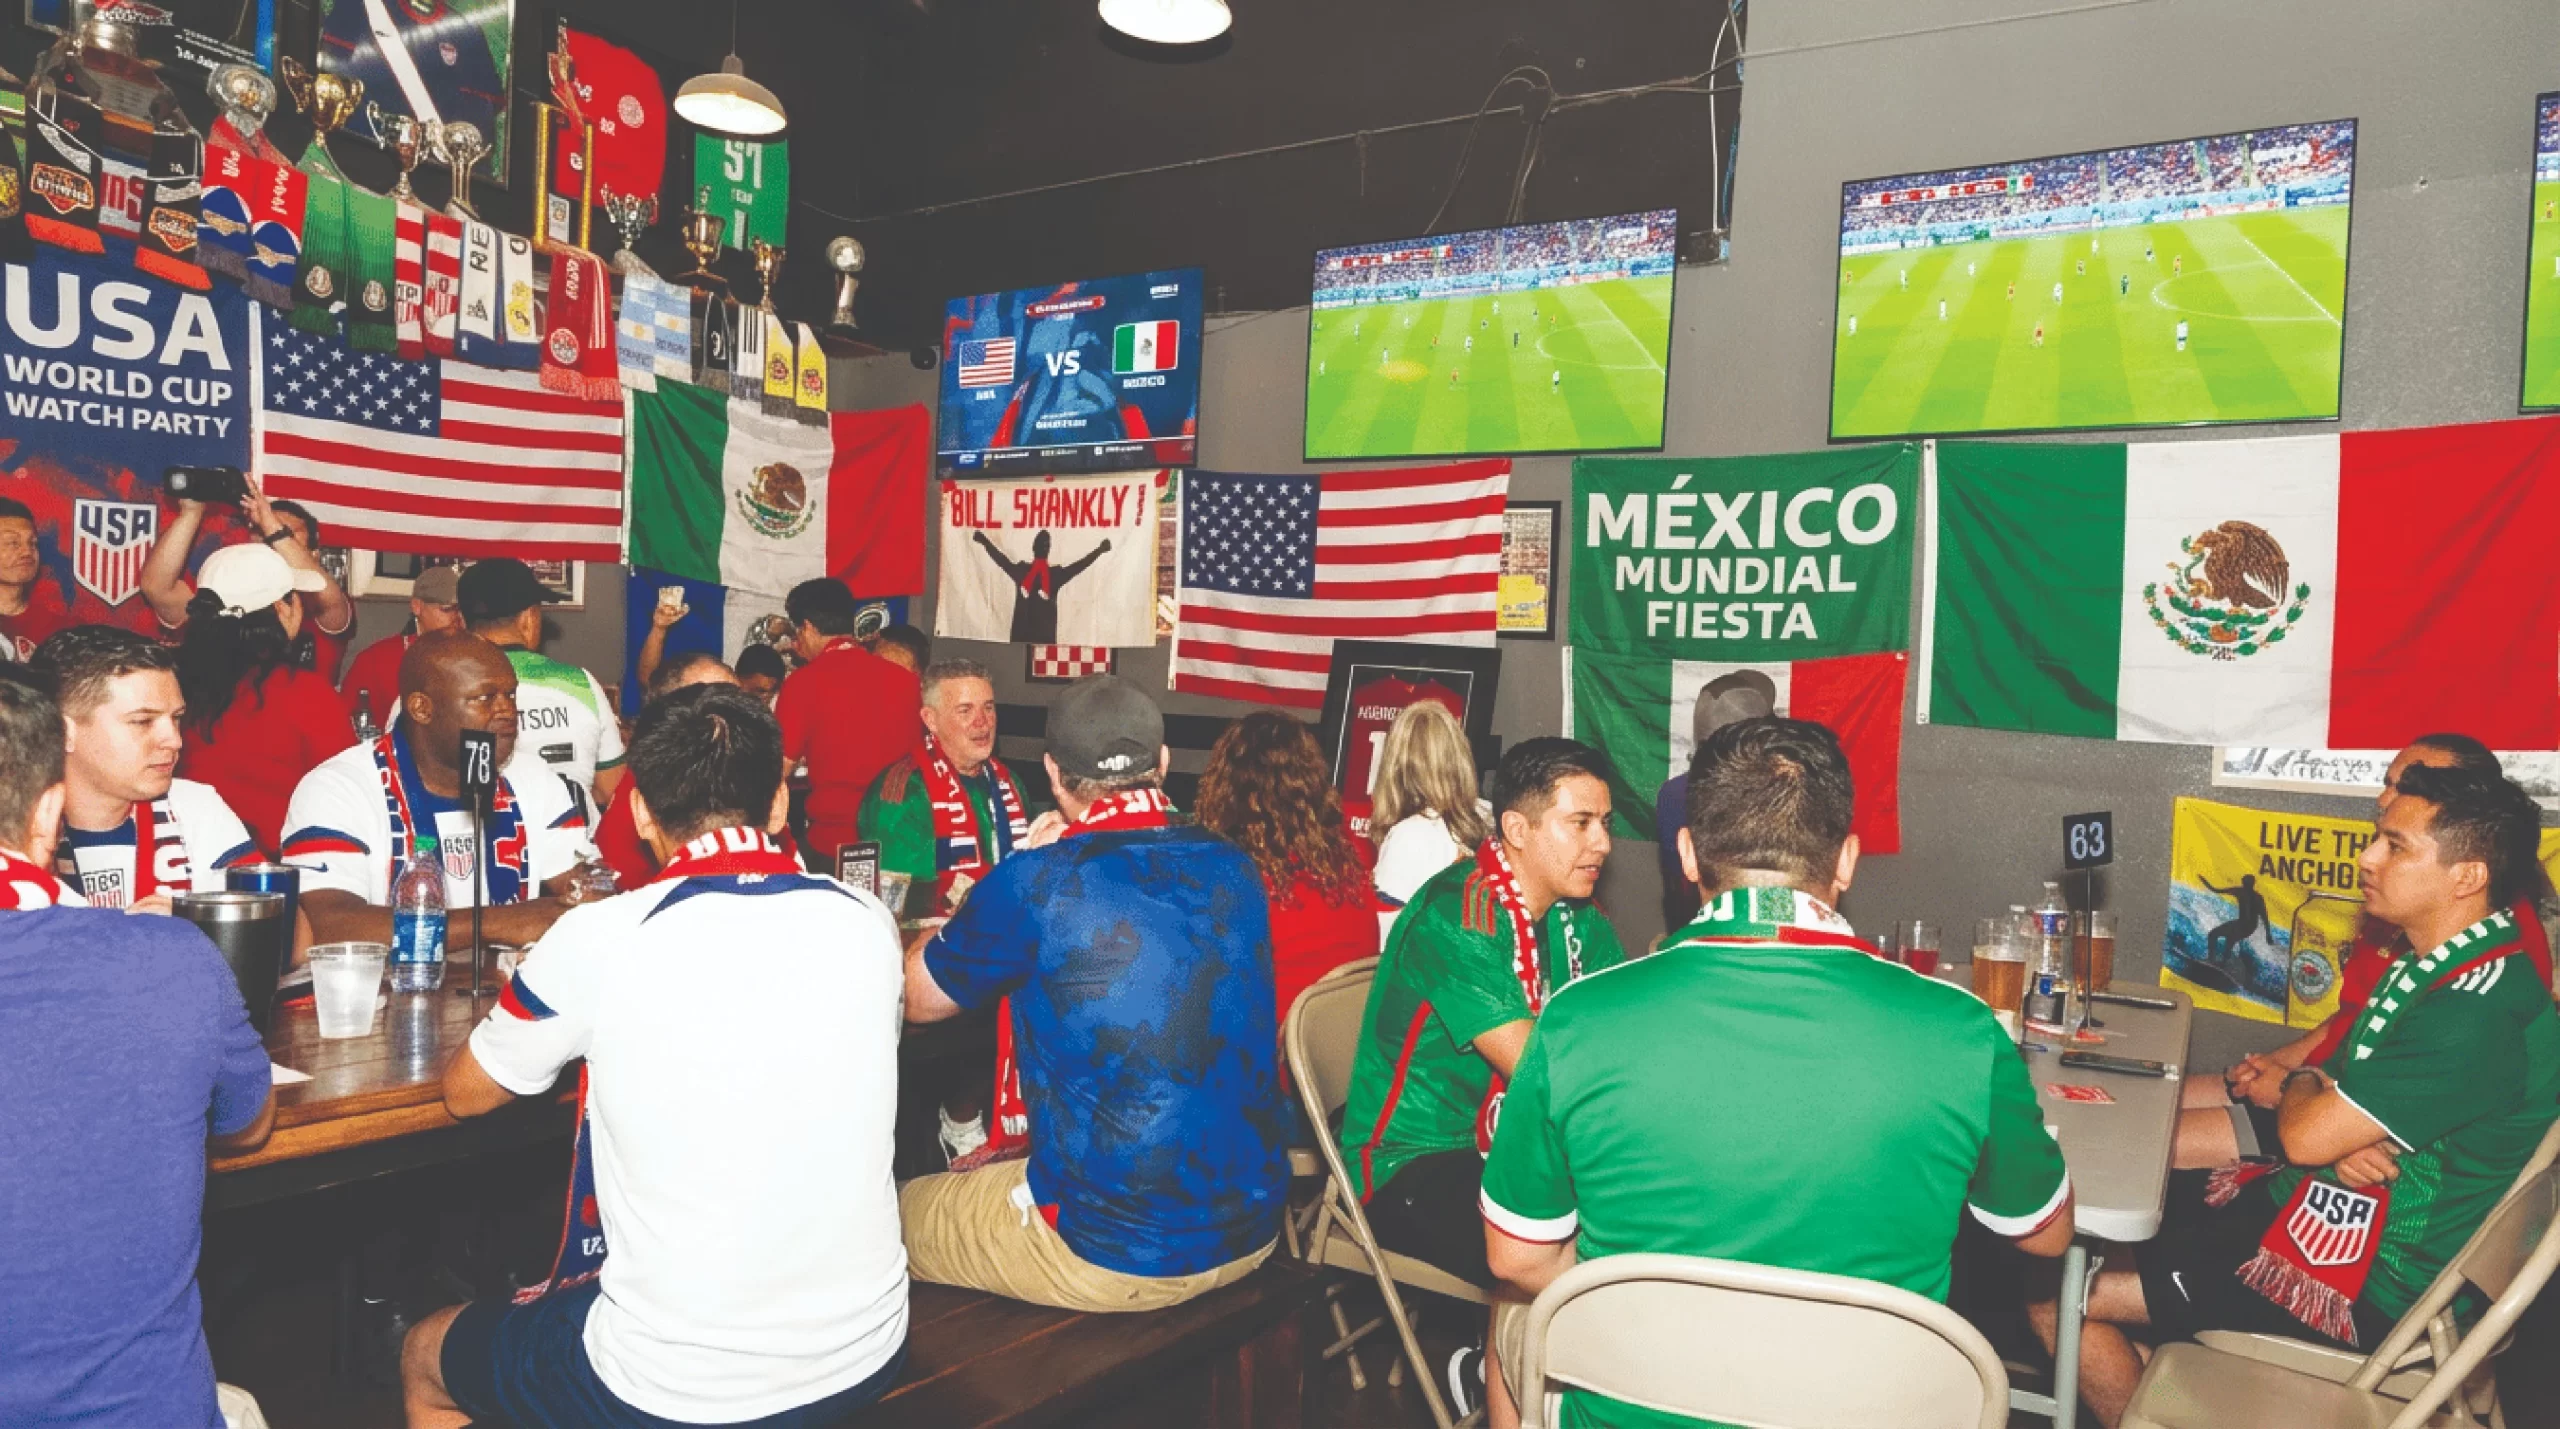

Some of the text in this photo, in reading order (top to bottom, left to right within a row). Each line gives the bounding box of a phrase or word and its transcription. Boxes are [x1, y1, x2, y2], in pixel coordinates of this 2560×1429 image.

[5, 262, 231, 371] USA
[3, 354, 233, 407] WORLD CUP
[1046, 350, 1081, 377] VS
[3, 391, 232, 438] WATCH PARTY
[80, 504, 152, 546] USA
[951, 488, 1002, 529] BILL
[1586, 474, 1898, 550] MÉXICO
[1615, 554, 1858, 594] MUNDIAL
[1646, 601, 1819, 640] FIESTA
[464, 740, 490, 785] 78
[2070, 821, 2105, 861] 63
[2259, 821, 2322, 854] LIVE
[2307, 1183, 2373, 1226] USA
